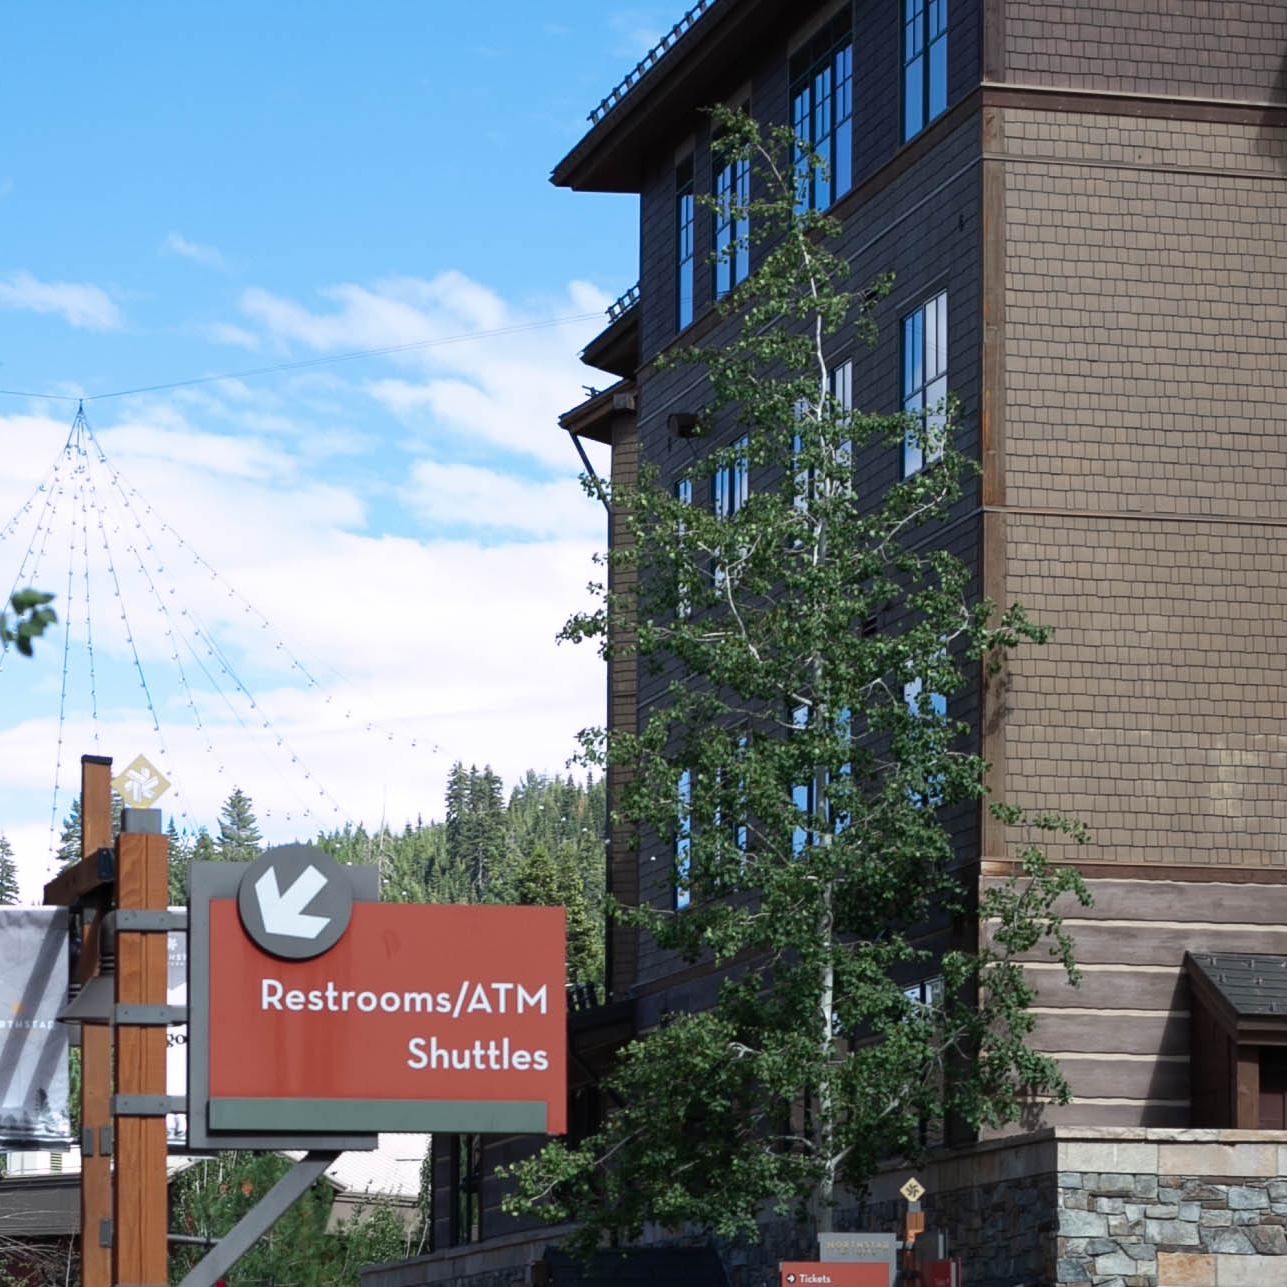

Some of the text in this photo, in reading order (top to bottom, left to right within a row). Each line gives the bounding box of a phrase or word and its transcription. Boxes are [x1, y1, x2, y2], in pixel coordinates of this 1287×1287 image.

[261, 978, 547, 1019] Restrooms/ATM
[407, 1036, 549, 1071] Shuttles
[799, 1273, 831, 1283] Tickets
